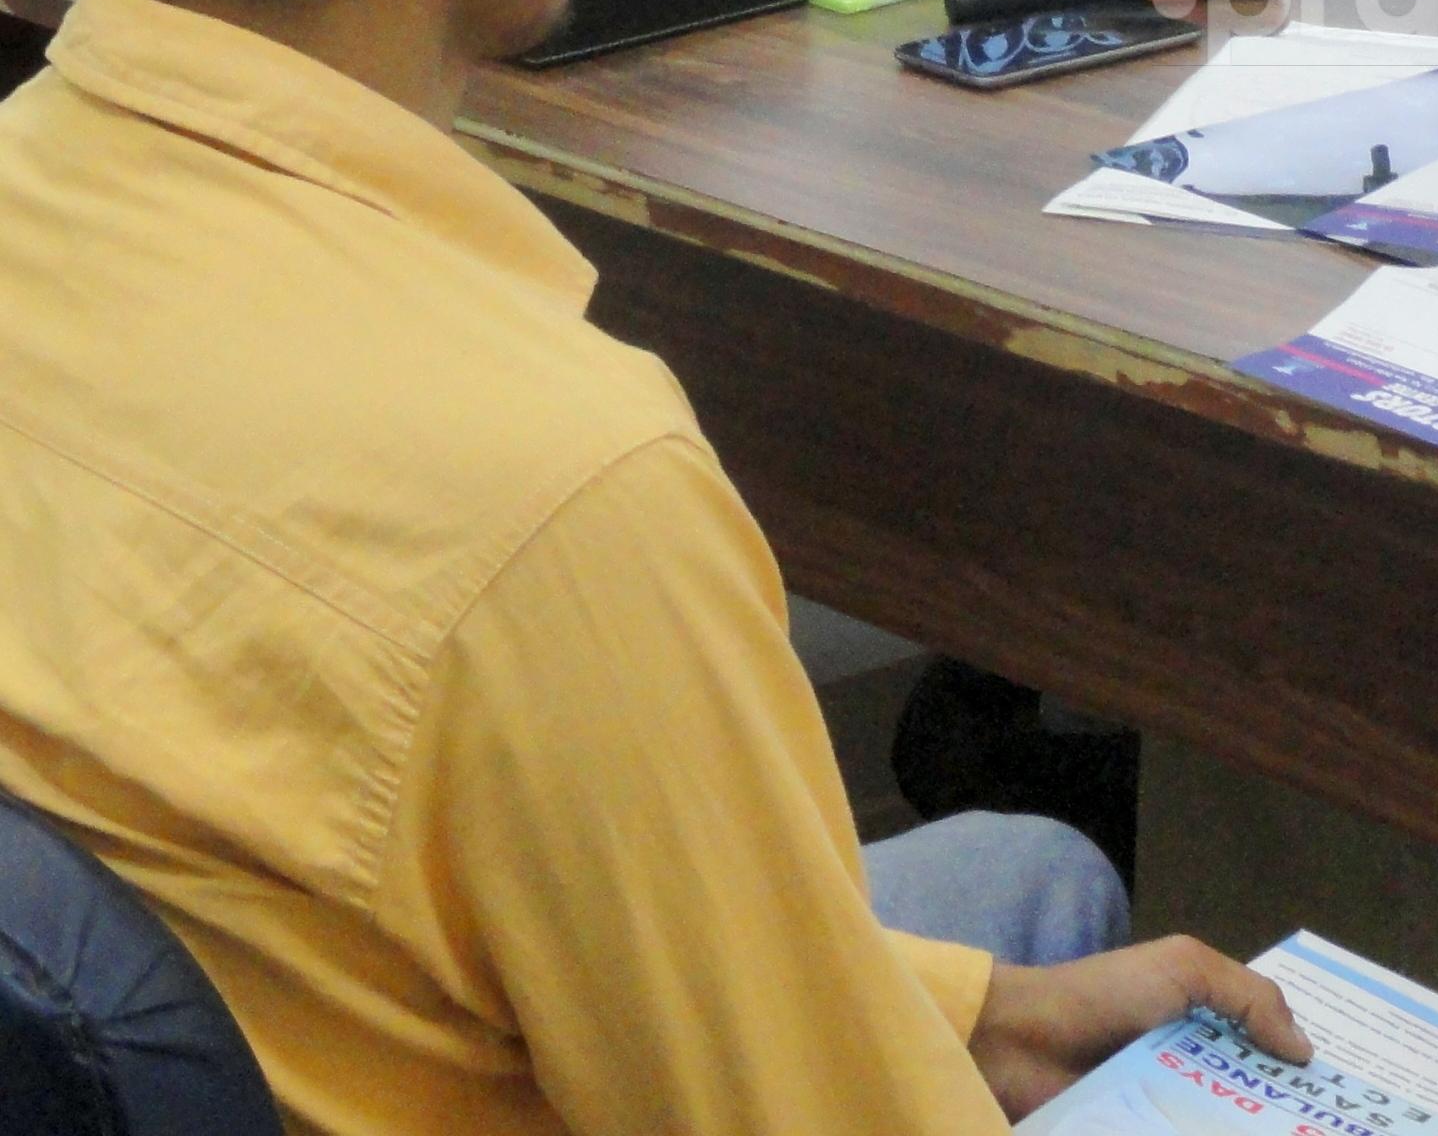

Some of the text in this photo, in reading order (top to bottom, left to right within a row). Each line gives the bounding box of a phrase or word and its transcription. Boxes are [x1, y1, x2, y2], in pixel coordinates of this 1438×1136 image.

[1156, 1050, 1264, 1114] DAYS
[1174, 1035, 1376, 1136] BULANCE
[1195, 1020, 1394, 1127] SAMPLE
